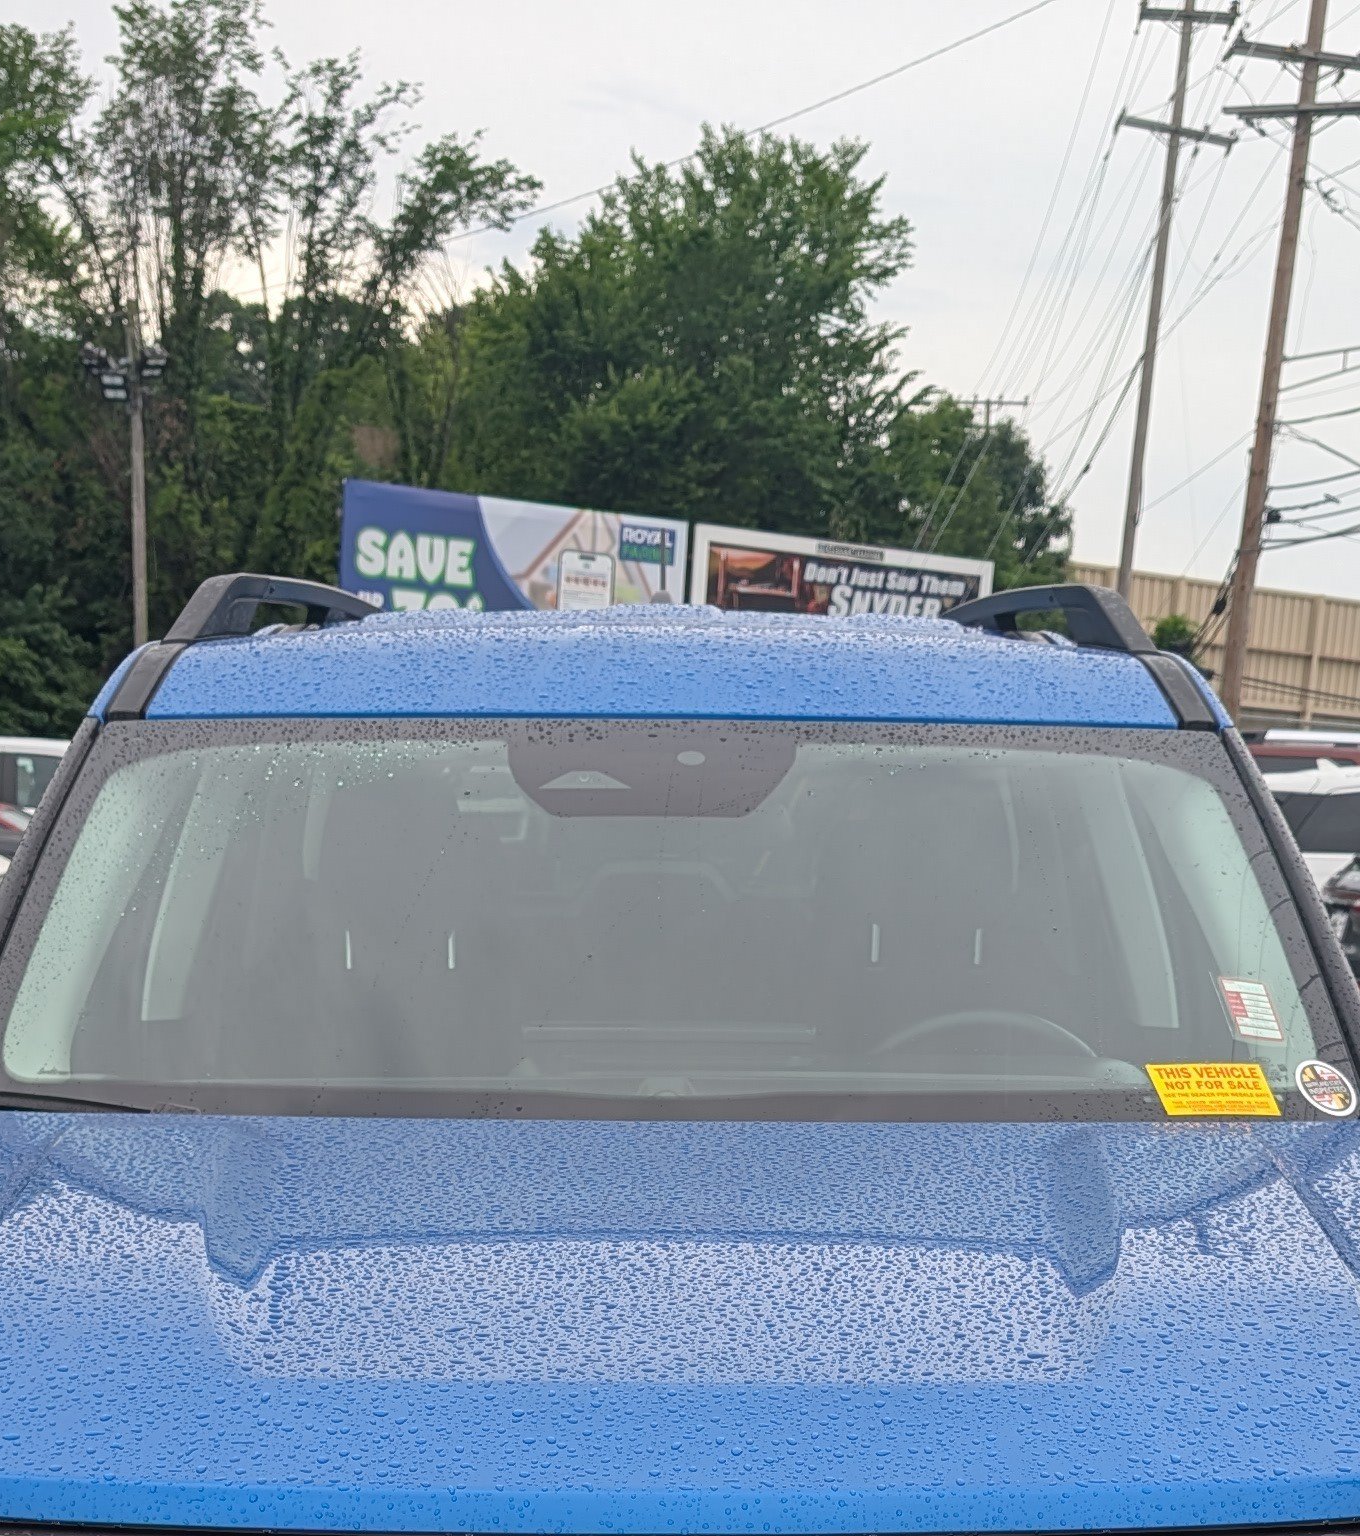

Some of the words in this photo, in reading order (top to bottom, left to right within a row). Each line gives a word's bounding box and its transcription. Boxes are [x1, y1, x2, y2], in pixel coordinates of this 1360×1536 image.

[355, 526, 475, 587] SAVE
[803, 562, 849, 585] Don't
[850, 567, 885, 589] Just
[886, 571, 919, 593] Sue
[920, 575, 966, 597] Them
[1153, 1066, 1192, 1080] THIS
[1193, 1066, 1261, 1079] VEHICLE
[1164, 1081, 1191, 1091] NOT
[1195, 1080, 1225, 1090] FOR
[1227, 1081, 1262, 1091] SALE
